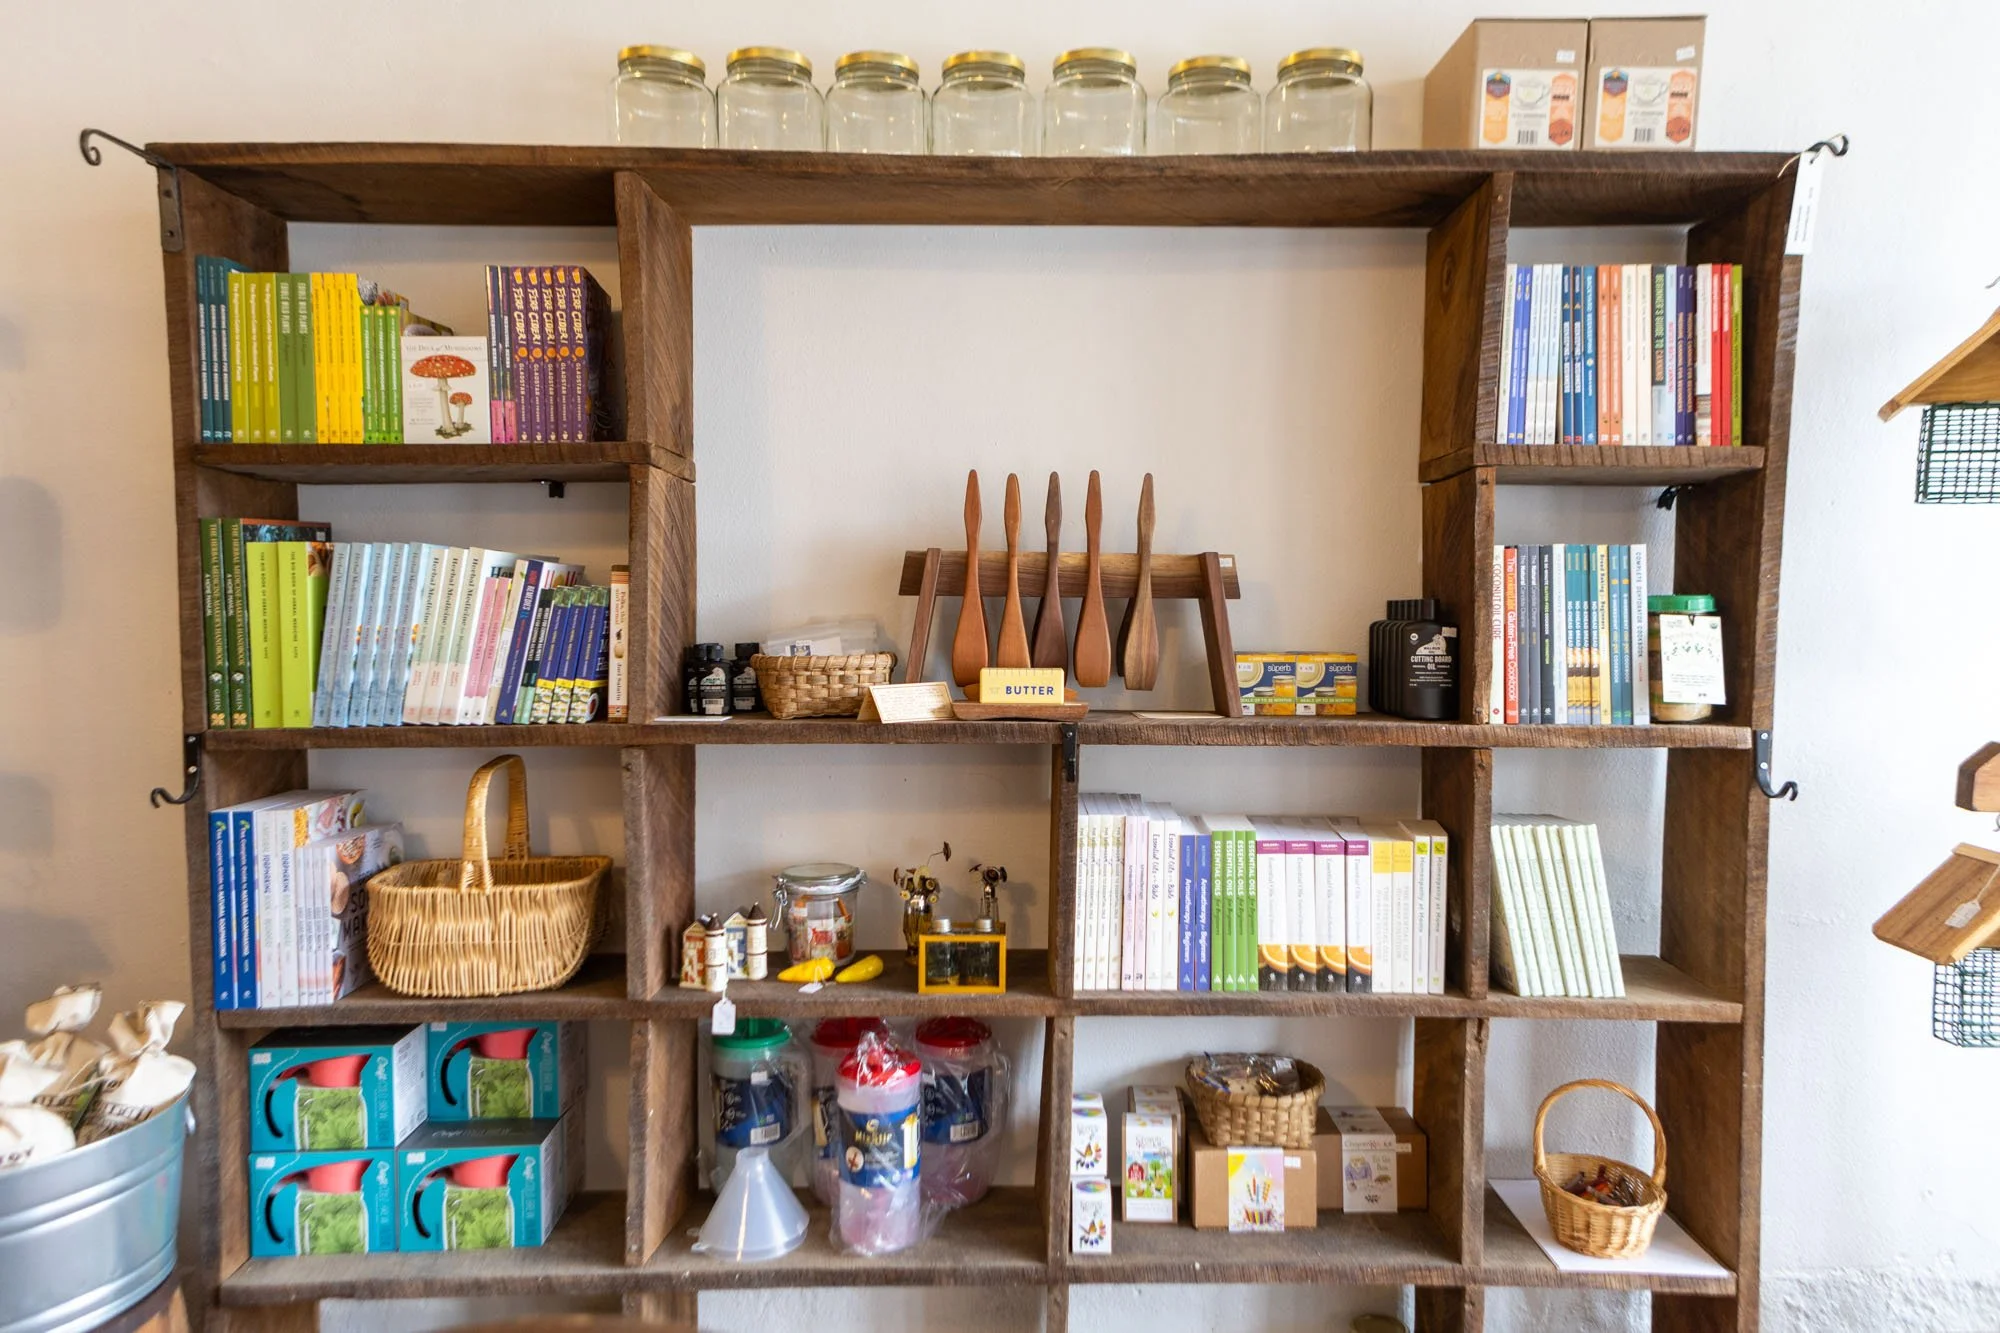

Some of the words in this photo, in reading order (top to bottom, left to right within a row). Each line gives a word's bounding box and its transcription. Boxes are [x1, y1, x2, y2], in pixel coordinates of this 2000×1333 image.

[430, 557, 440, 585] Herbal
[449, 558, 459, 585] Herbal
[468, 558, 479, 586] Herbal
[1507, 558, 1515, 572] The
[423, 588, 435, 625] Medicine
[442, 588, 454, 625] Medicine
[461, 588, 473, 626] Medicine
[1507, 611, 1515, 660] Gluten-Free
[1411, 655, 1434, 663] CUTTING
[1435, 655, 1452, 663] BOARD
[1006, 686, 1054, 695] BUTTER
[1508, 661, 1516, 701] Cookbook
[1183, 879, 1191, 924] Aromatherapy
[1199, 879, 1207, 924] Aromatherapy
[1183, 931, 1191, 963] Beginners
[1199, 931, 1207, 963] Beginners
